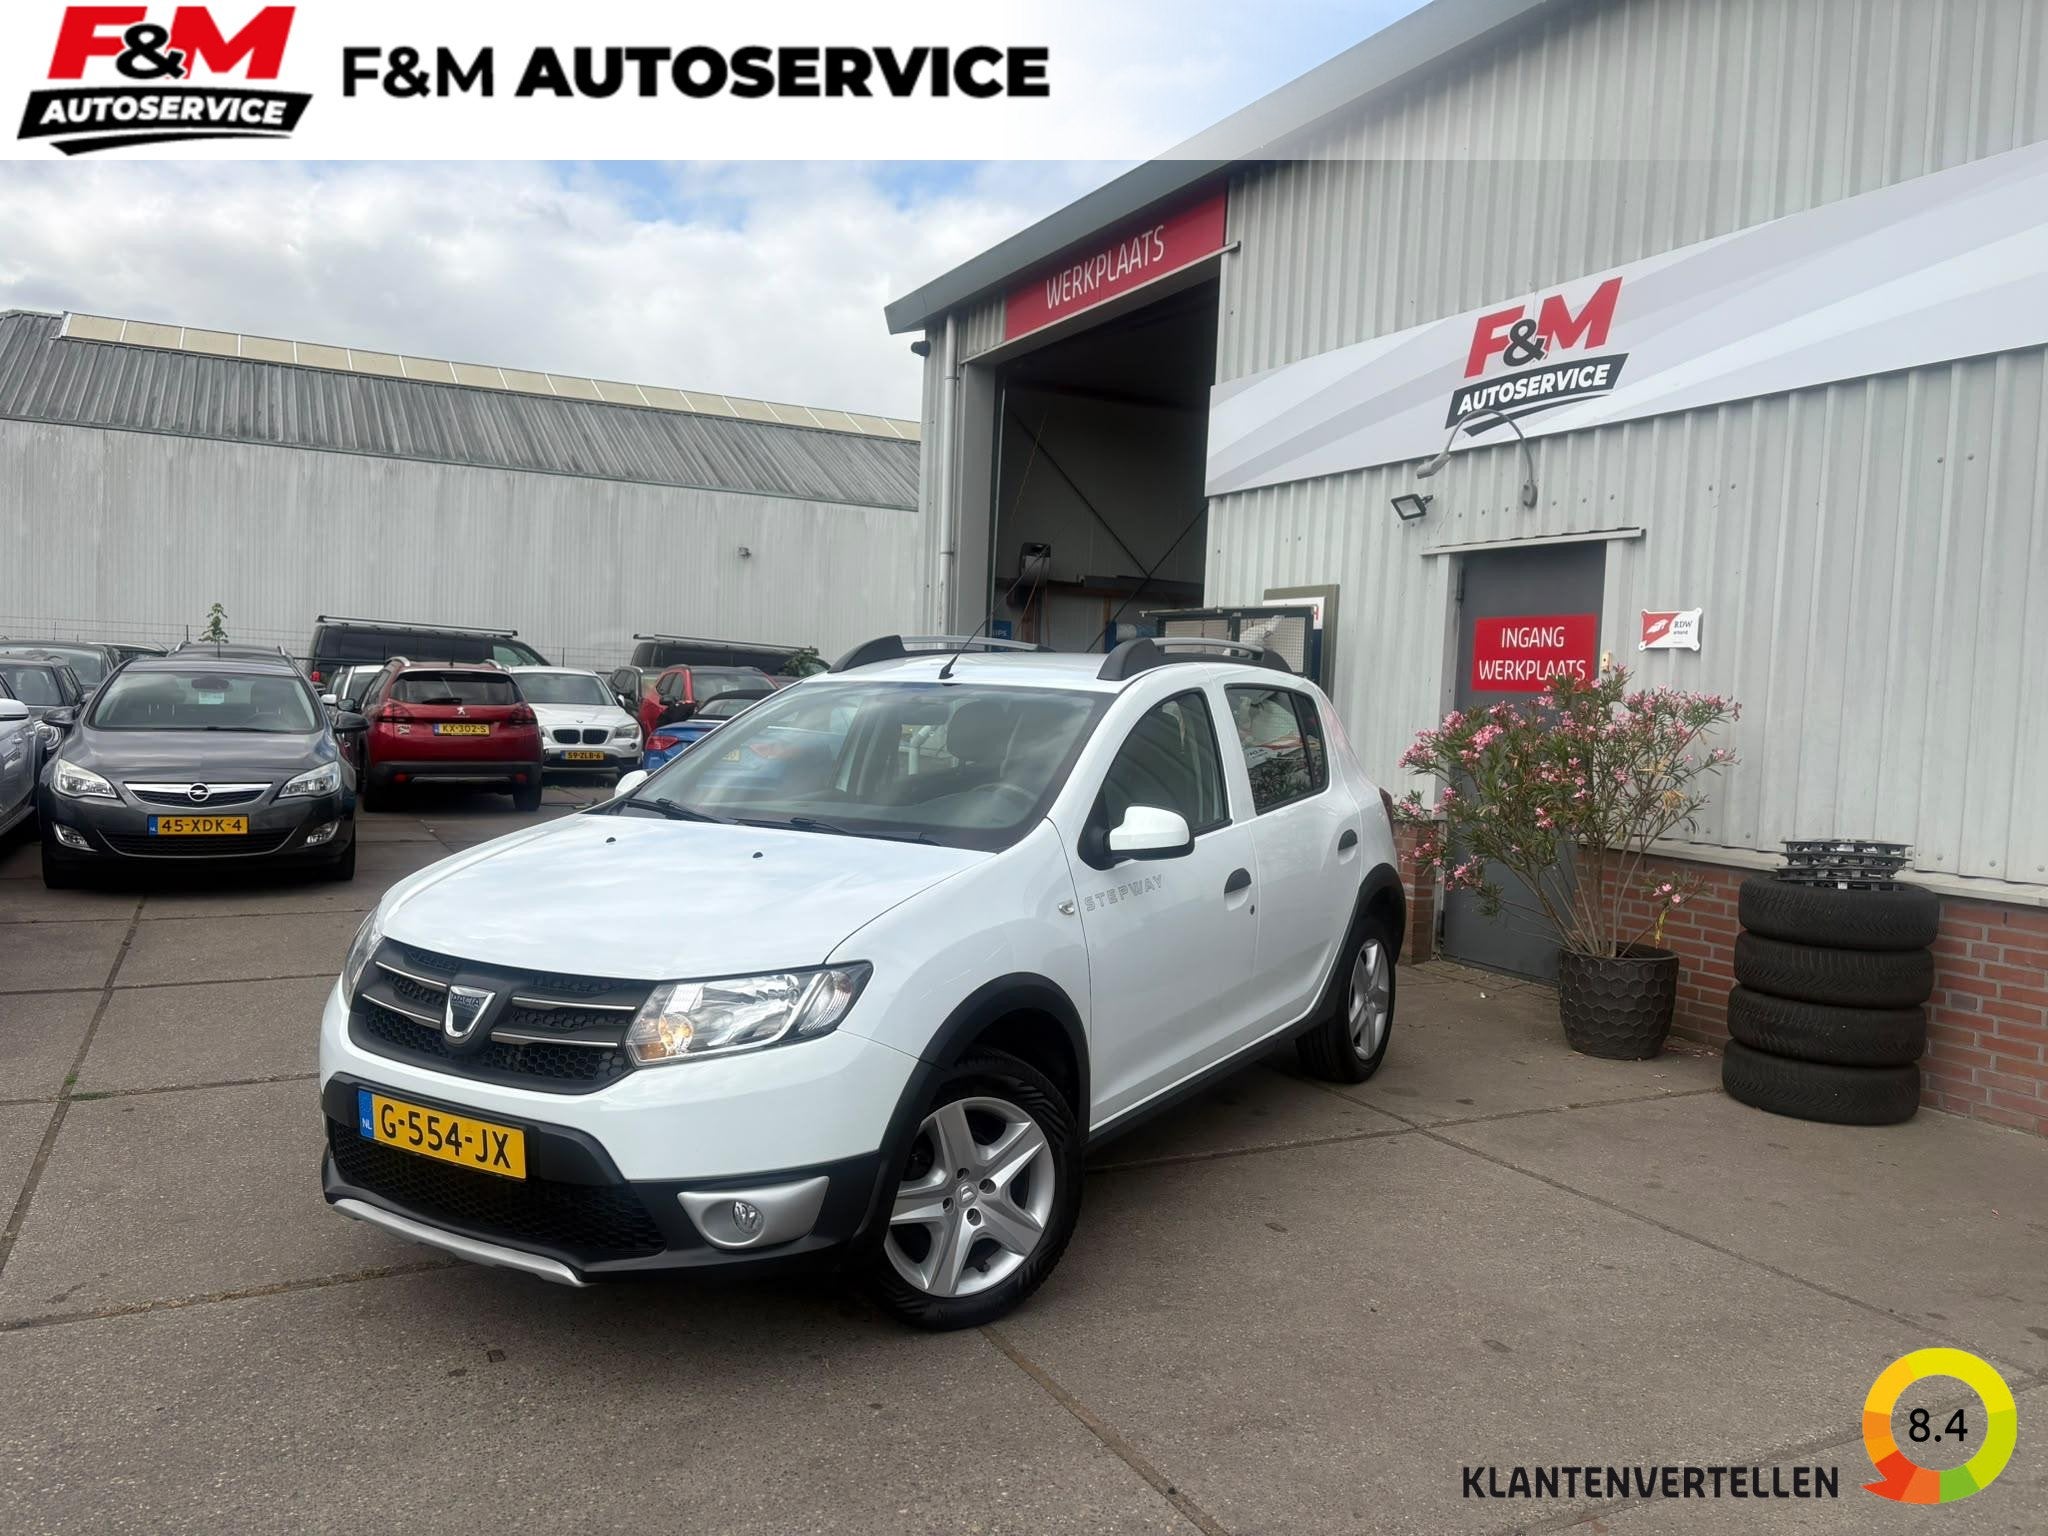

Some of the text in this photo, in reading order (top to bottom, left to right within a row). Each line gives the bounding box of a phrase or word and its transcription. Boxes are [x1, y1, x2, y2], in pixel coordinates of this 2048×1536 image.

[1046, 224, 1164, 310] WERKPLAATS
[1464, 276, 1623, 379] F&M
[1457, 364, 1611, 416] AUTOSERVICE
[1501, 626, 1565, 648] INGANG
[1479, 659, 1586, 681] WERKPLAATS
[442, 723, 487, 734] KX-302-S
[161, 819, 242, 832] 45-XDK-4
[1084, 874, 1162, 912] STEPWAY
[450, 993, 480, 1007] DACIA
[362, 1104, 512, 1169] NL G-554-JX
